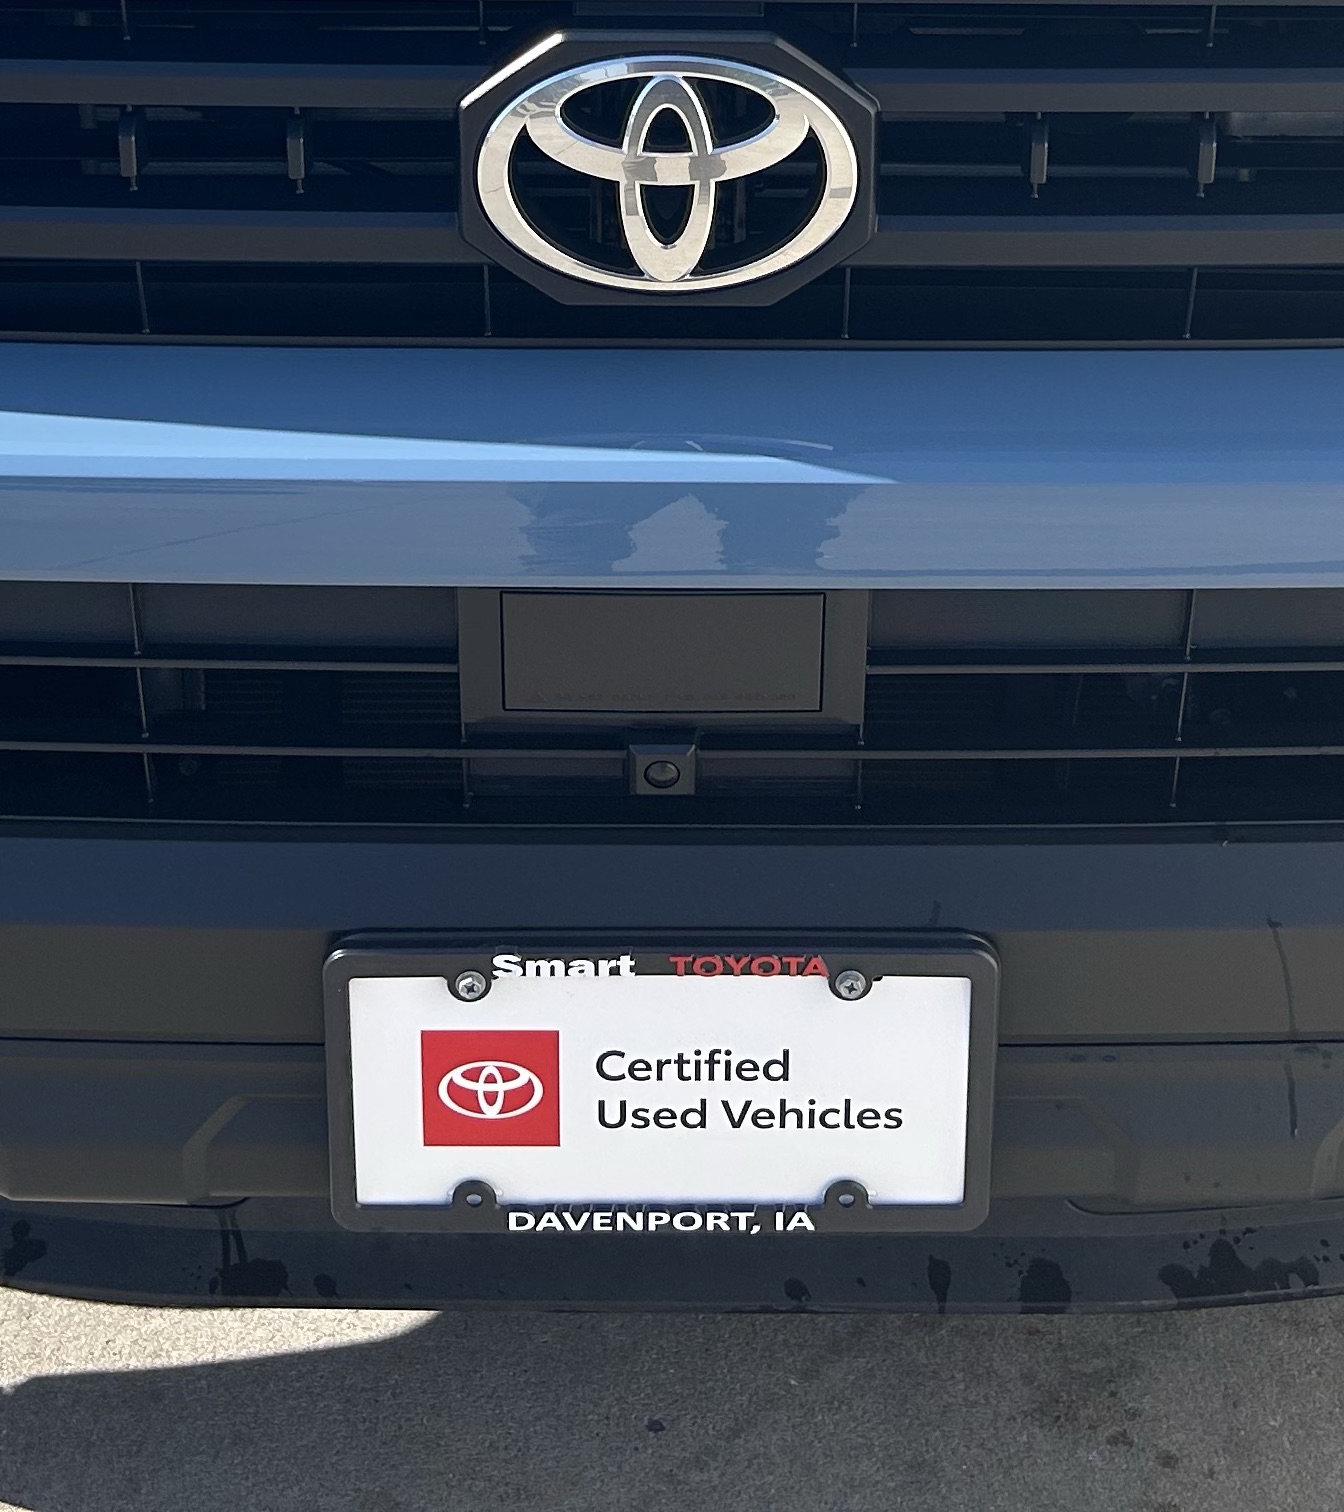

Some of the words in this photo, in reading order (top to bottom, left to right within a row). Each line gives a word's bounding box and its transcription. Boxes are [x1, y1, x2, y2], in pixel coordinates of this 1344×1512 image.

[491, 954, 636, 978] Smart
[669, 953, 830, 977] TOYOTA
[595, 1048, 789, 1082] Certified
[598, 1098, 707, 1130] Used
[720, 1098, 903, 1130] Vehicles
[507, 1211, 761, 1235] DAVENPORT,
[774, 1211, 816, 1231] IA
